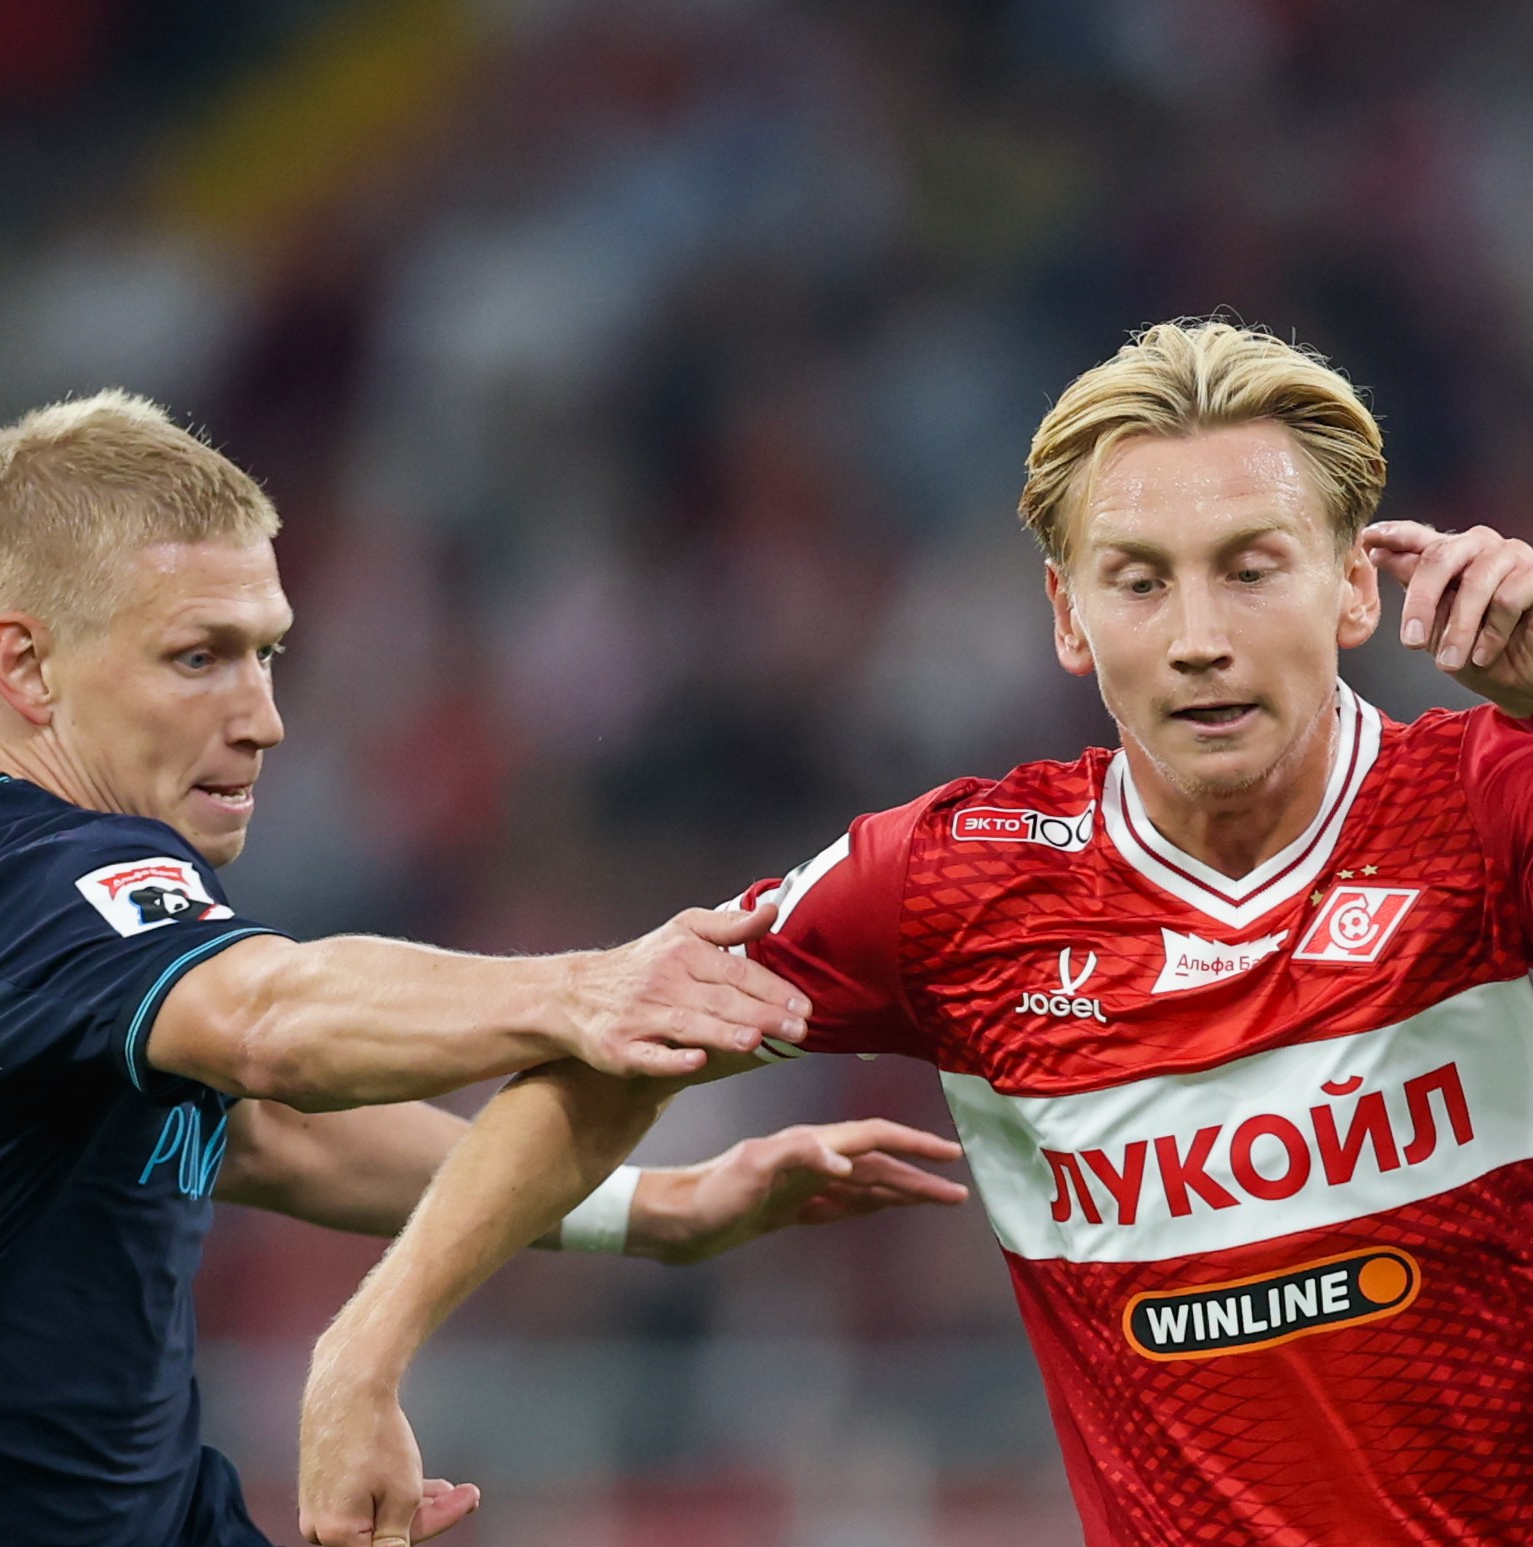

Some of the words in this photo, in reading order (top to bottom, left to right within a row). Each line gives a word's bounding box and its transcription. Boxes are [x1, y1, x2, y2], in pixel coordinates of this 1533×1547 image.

[1175, 953, 1235, 976] Альфа
[1039, 1061, 1474, 1226] ЛУКОЙЛ
[1146, 1269, 1350, 1346] WINLINE
